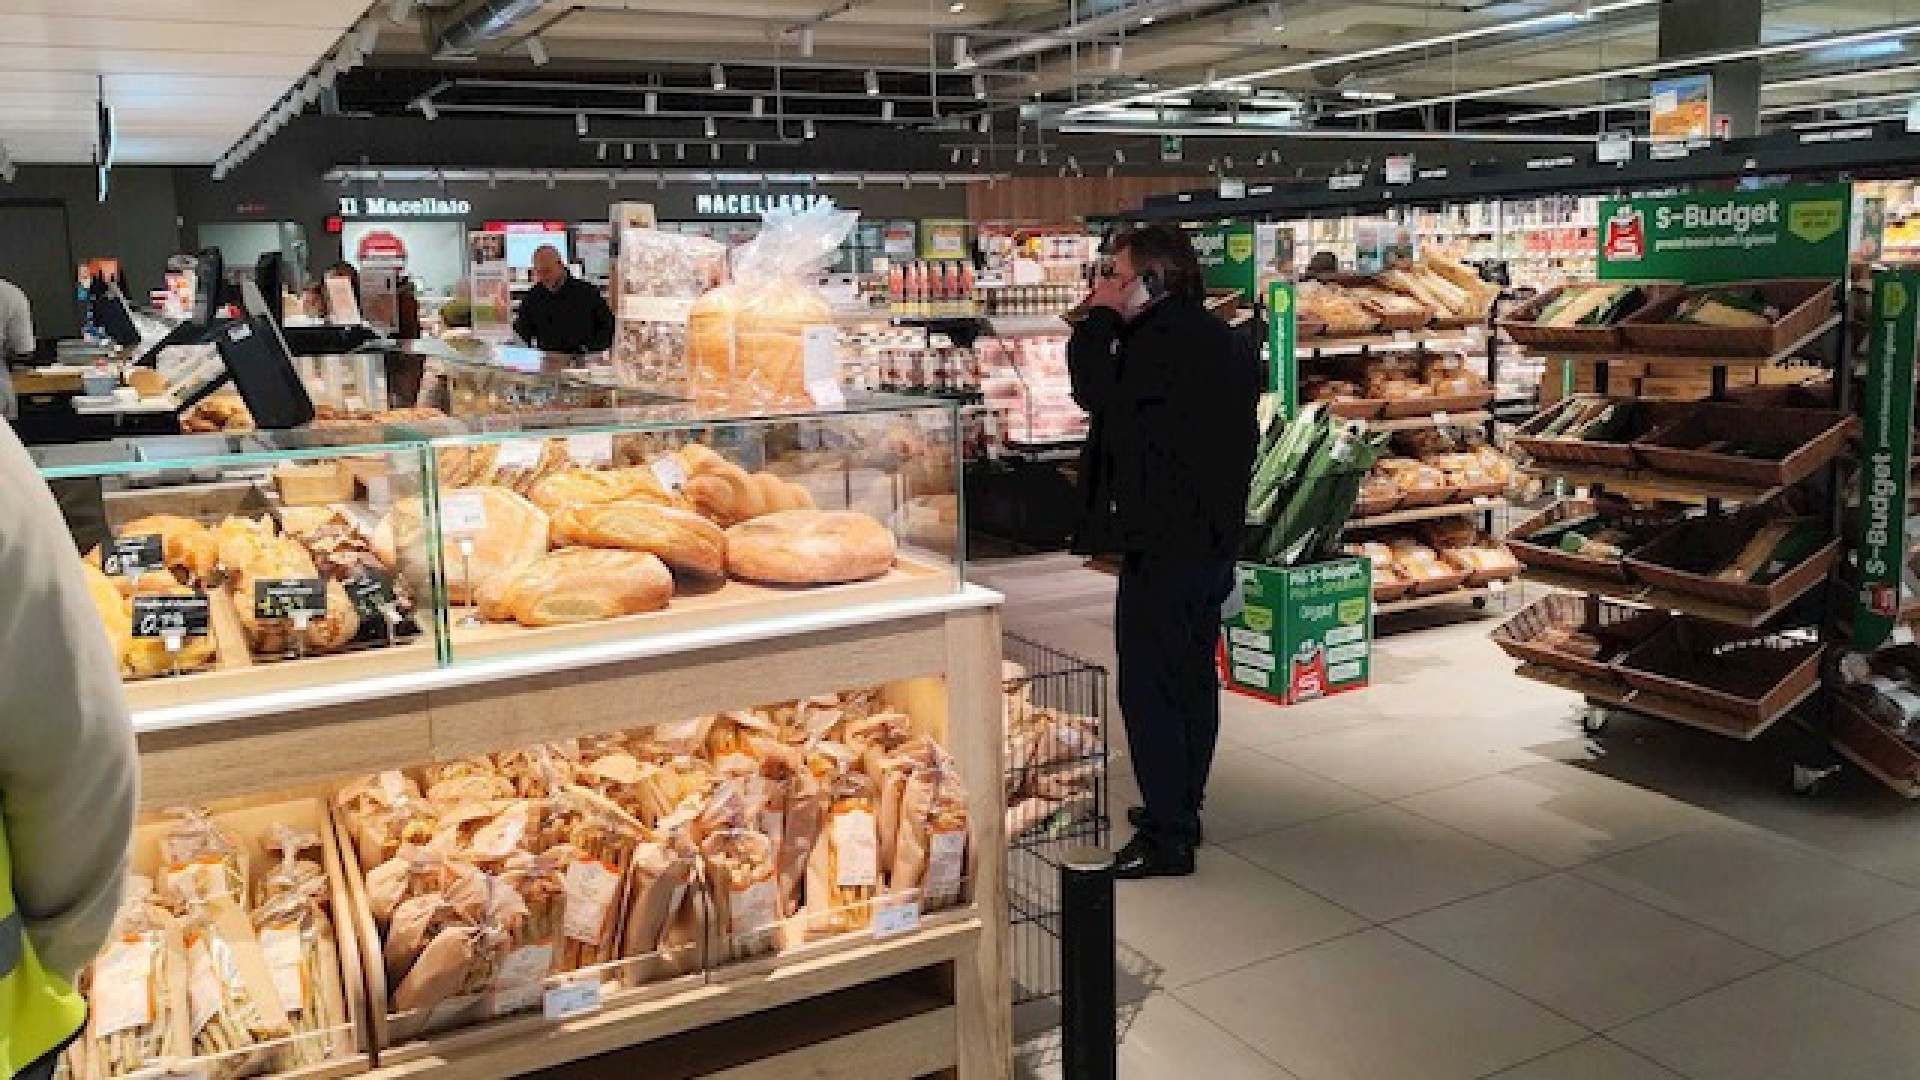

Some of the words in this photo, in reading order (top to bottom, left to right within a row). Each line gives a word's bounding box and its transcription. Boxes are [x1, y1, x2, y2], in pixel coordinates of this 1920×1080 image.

[365, 197, 472, 215] Macellaio
[1655, 199, 1780, 232] S-Budget
[1865, 452, 1897, 576] S-Budget
